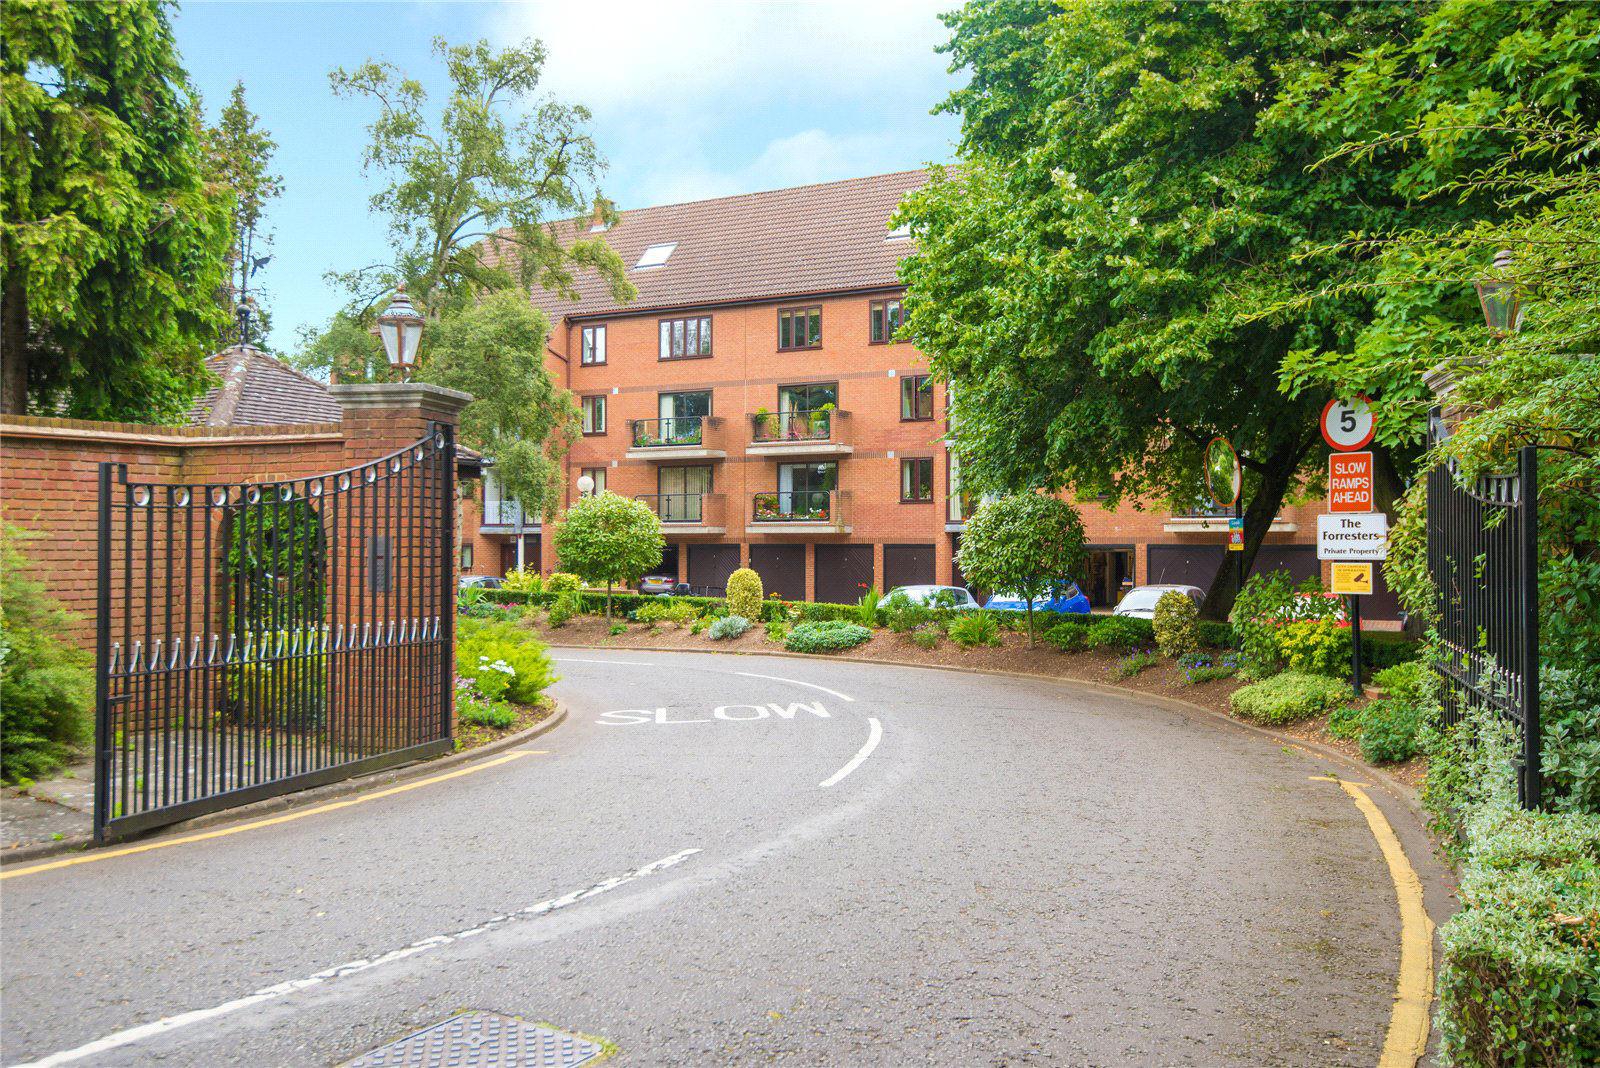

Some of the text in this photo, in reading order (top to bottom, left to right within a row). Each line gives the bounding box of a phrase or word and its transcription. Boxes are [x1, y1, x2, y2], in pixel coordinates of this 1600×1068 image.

[1340, 410, 1357, 432] 5
[1335, 462, 1366, 474] SLOW
[1332, 477, 1369, 490] RAMPS
[1333, 491, 1369, 503] AHEAD
[1340, 518, 1361, 528] The
[1323, 531, 1380, 540] Forresters
[1349, 548, 1379, 556] Property
[595, 701, 831, 725] SLOW
